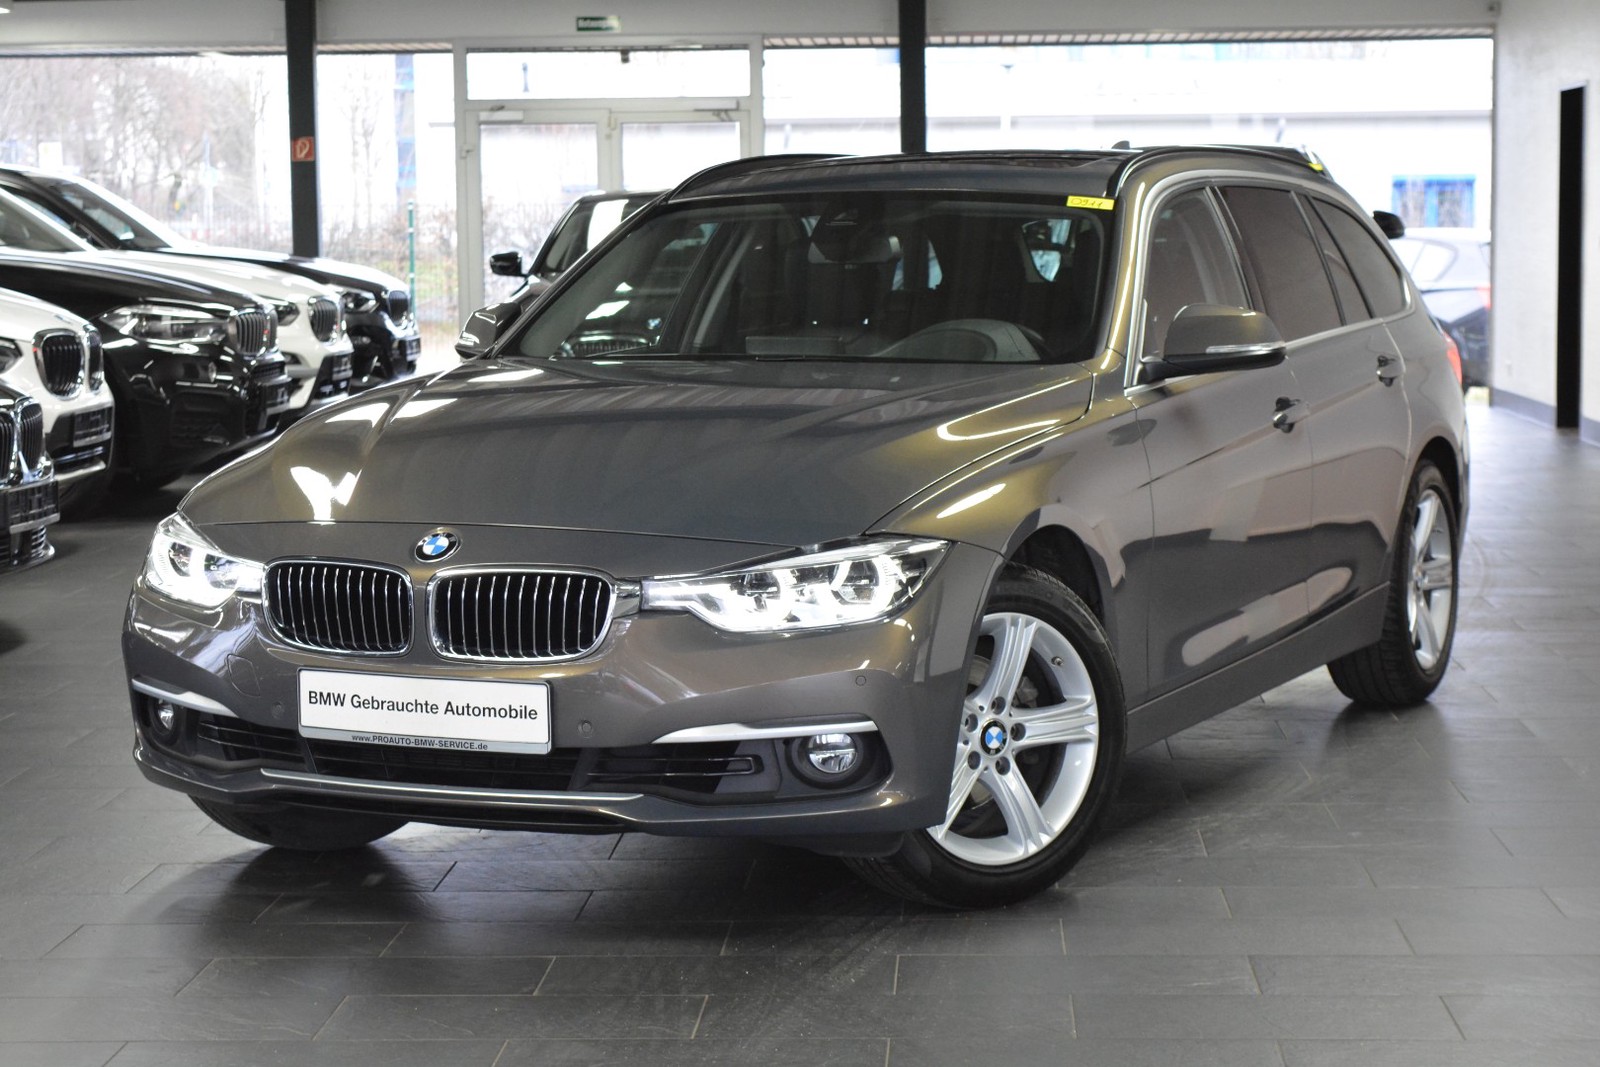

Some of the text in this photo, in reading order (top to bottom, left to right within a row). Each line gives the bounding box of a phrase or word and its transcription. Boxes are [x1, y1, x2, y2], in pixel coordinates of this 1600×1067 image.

[308, 690, 538, 720] BMW Gebrauchte Automobile
[351, 734, 488, 750] www.PROAUTO-BMW-SERVICE.de
